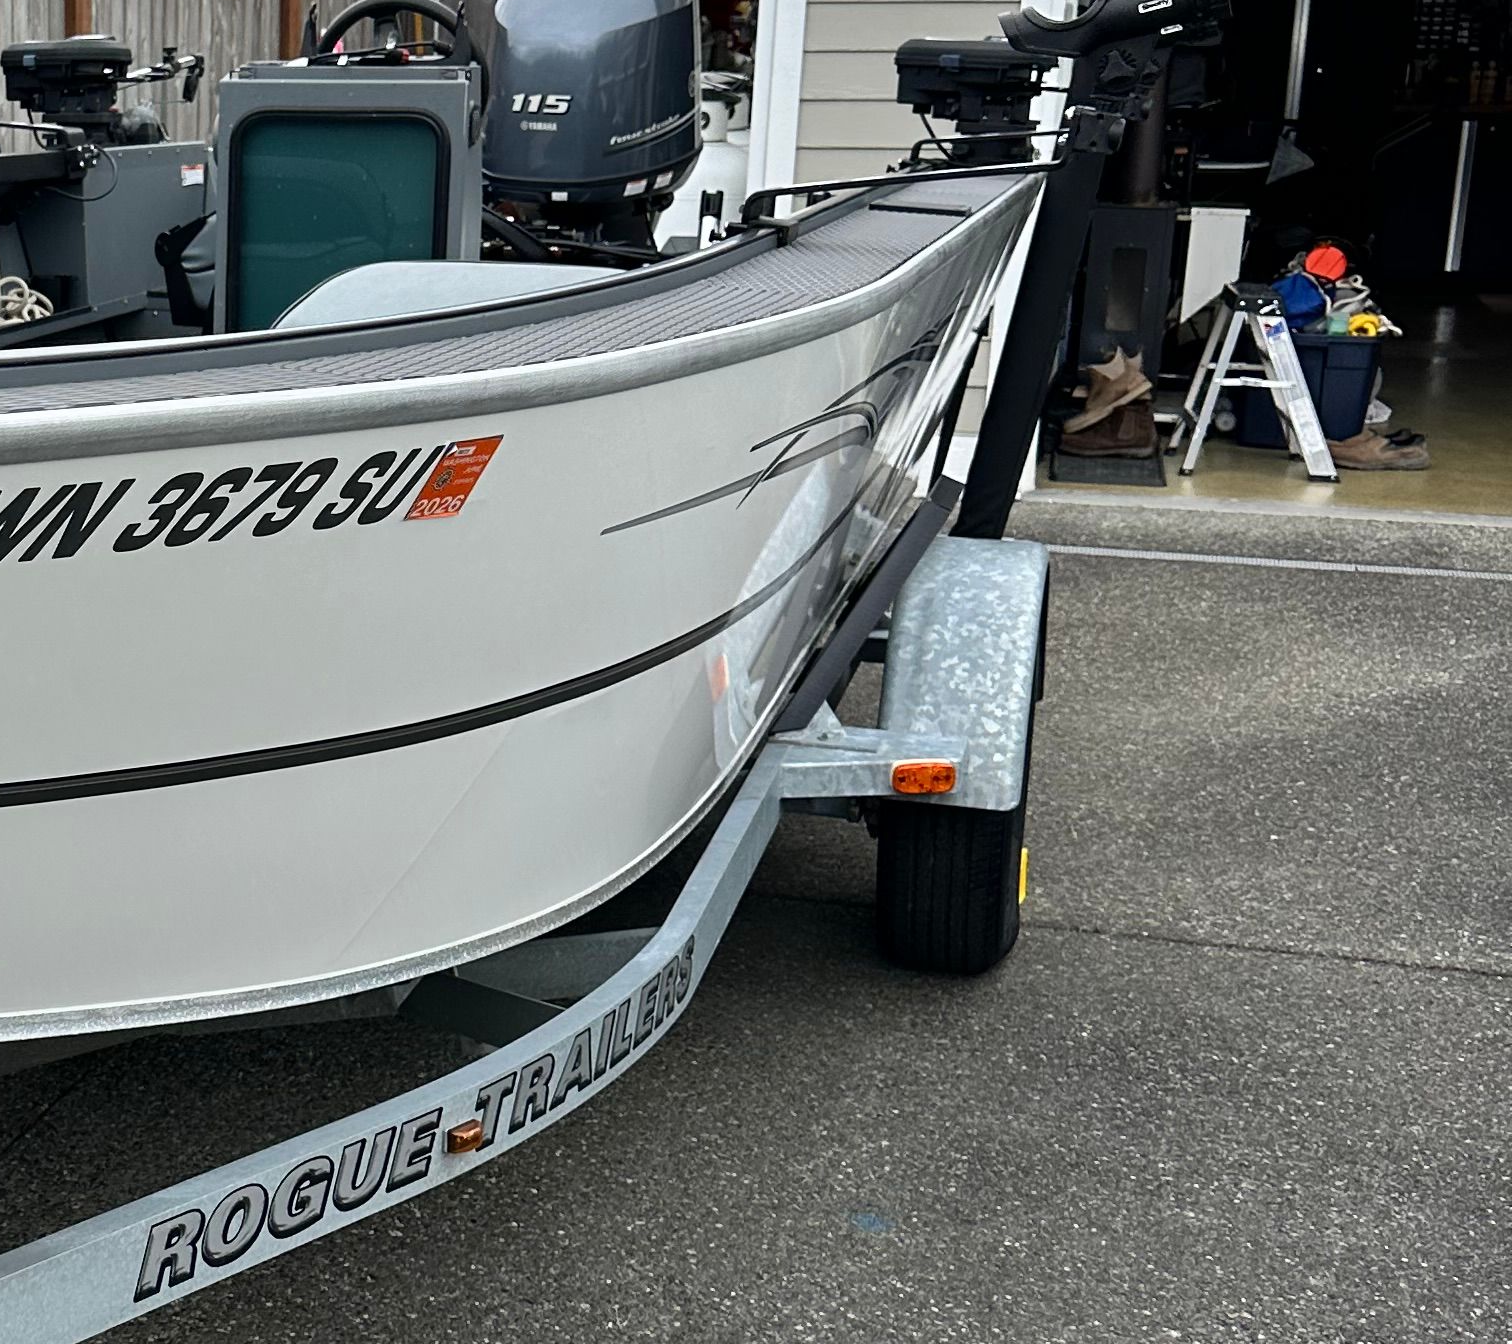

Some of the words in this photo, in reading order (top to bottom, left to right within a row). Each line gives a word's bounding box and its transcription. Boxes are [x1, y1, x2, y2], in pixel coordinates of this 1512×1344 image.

[511, 93, 573, 115] 115
[527, 121, 558, 132] YAMAHA
[112, 457, 339, 554] 3679
[312, 444, 446, 531] SU
[411, 494, 465, 517] 2026
[133, 1106, 444, 1303] ROGUE
[474, 935, 696, 1153] TRAILERS
